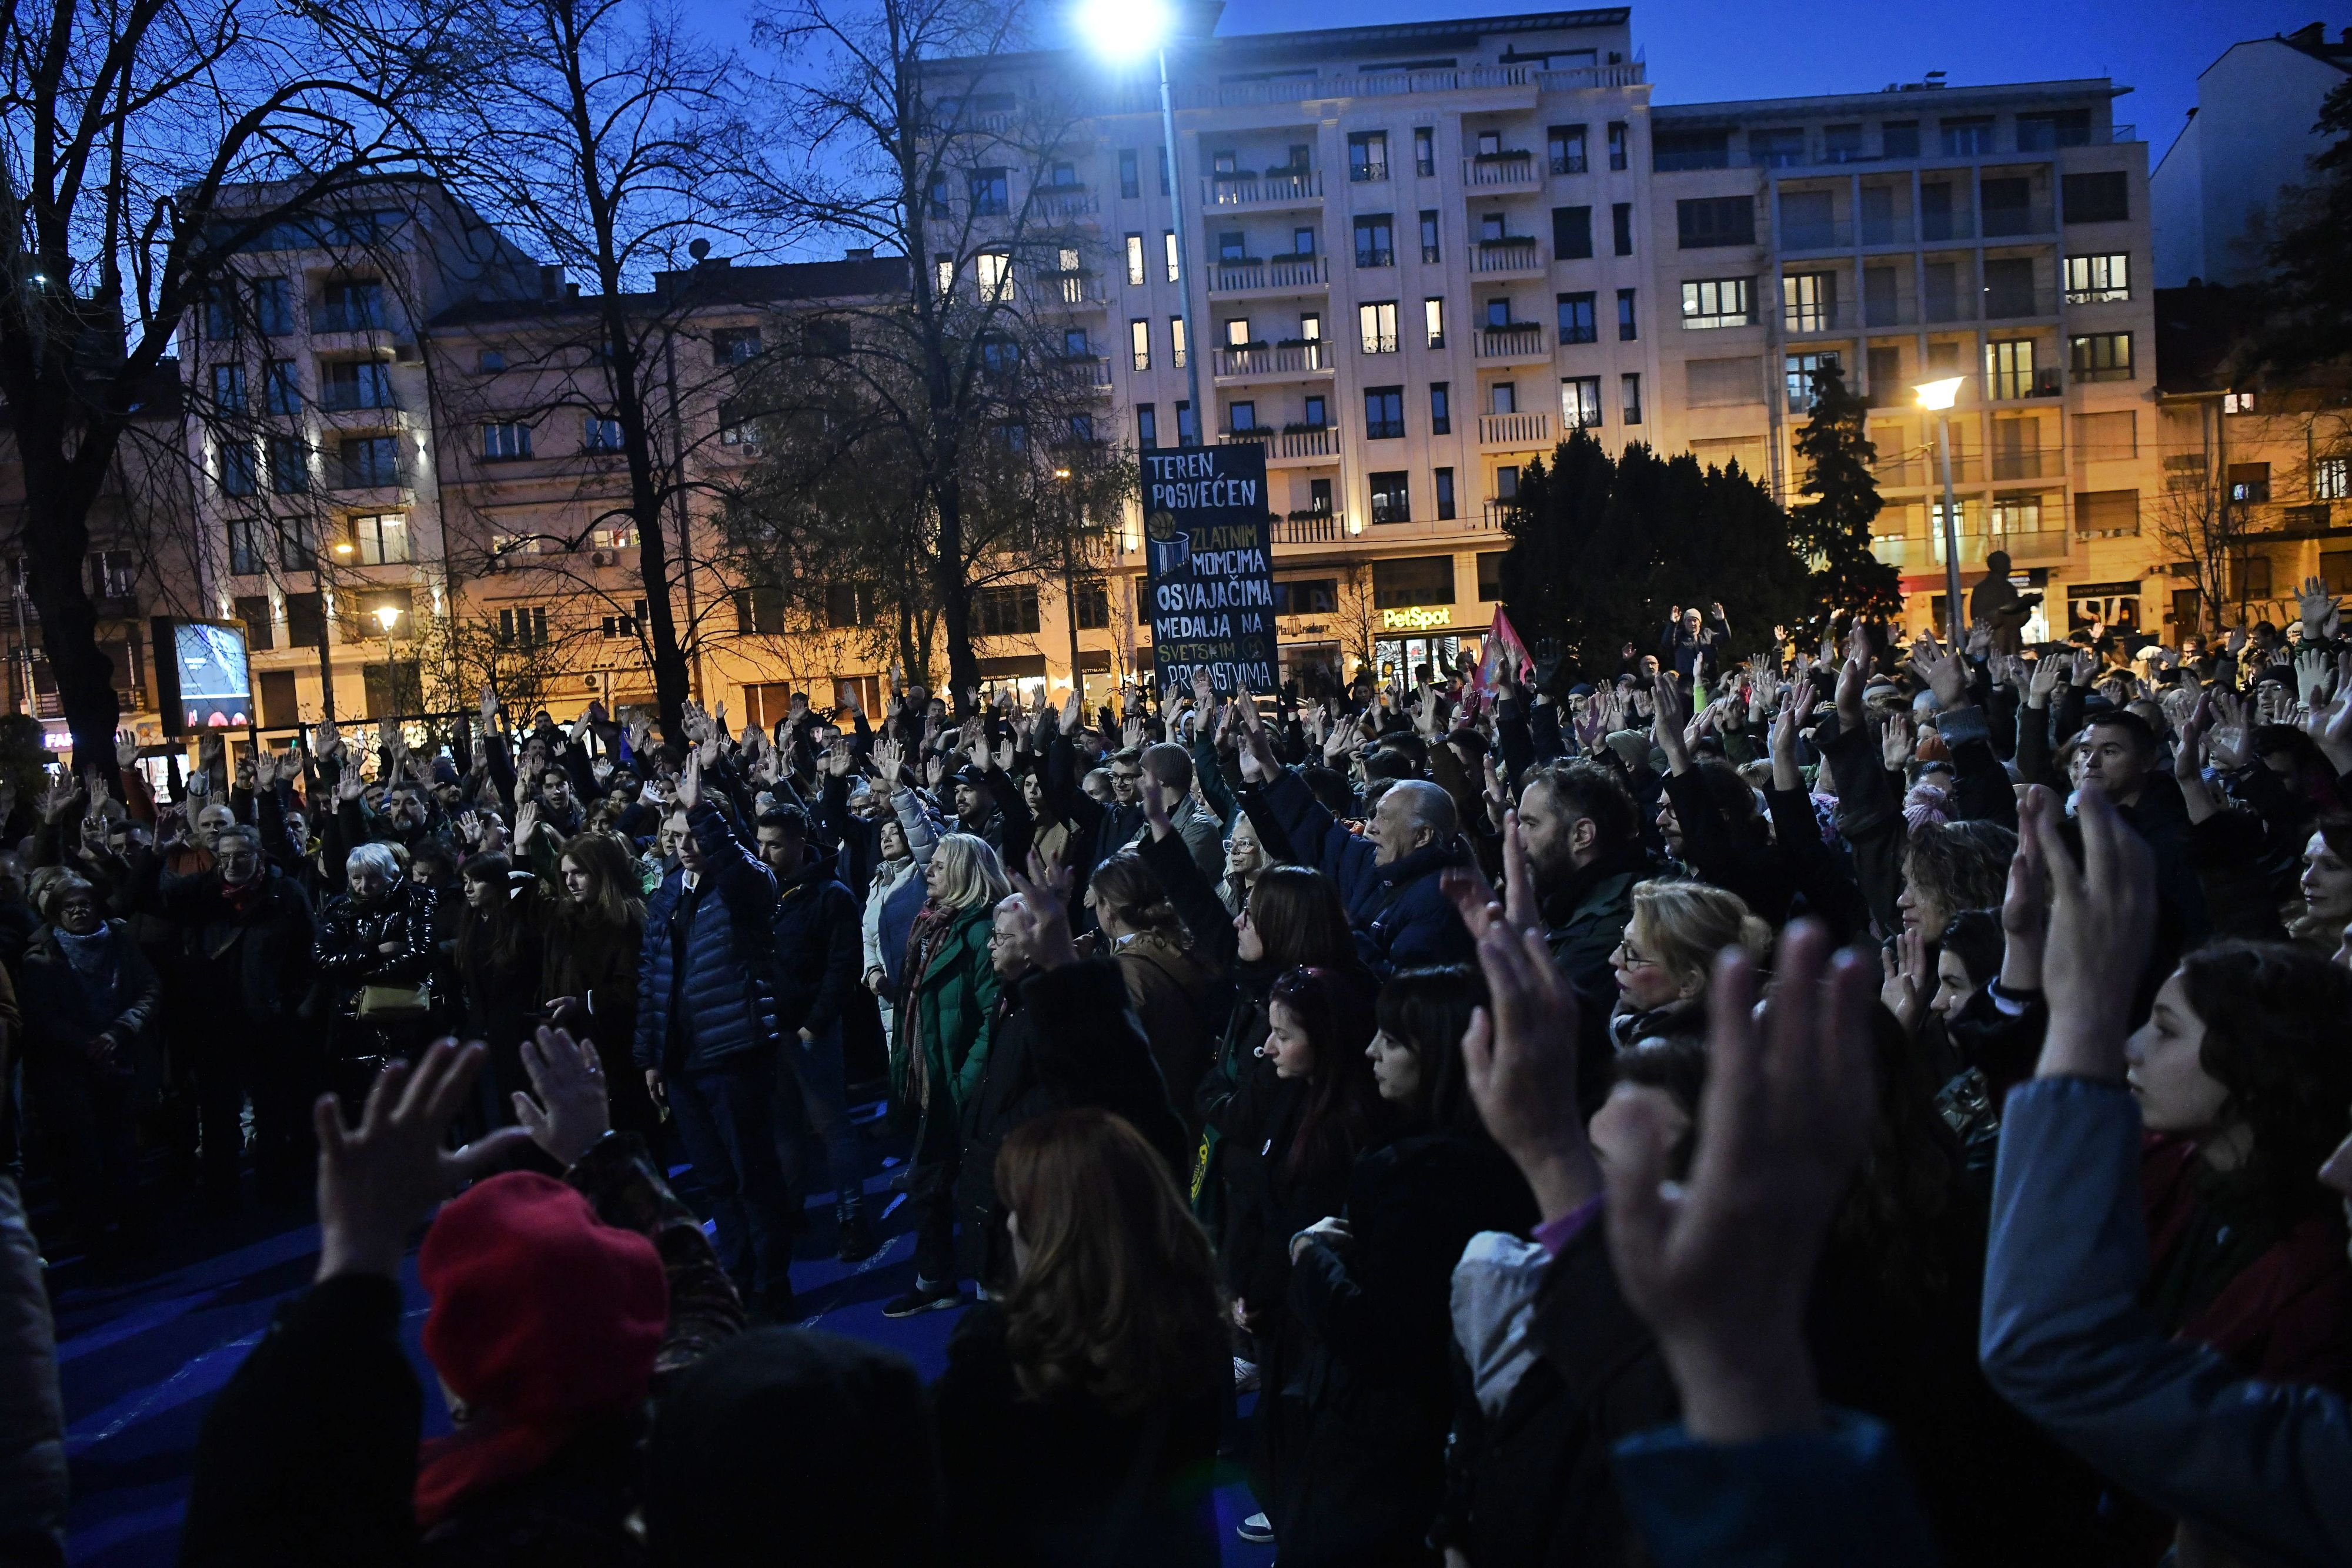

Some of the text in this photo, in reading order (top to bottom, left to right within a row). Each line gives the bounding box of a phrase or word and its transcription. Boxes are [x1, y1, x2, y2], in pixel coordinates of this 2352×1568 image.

[1147, 452, 1213, 480] TEREN
[1152, 472, 1255, 509] POSVEĆEN
[1190, 524, 1257, 551] ZLATNIM
[1192, 549, 1266, 576] MOMCIMA
[1157, 574, 1272, 611] OSVAJAČIMA
[1157, 611, 1262, 640] MEDALJA NA
[1384, 606, 1451, 630] PetSpot
[1158, 640, 1235, 663] SVETSKIM
[1168, 661, 1271, 691] PRVNSTVIMA
